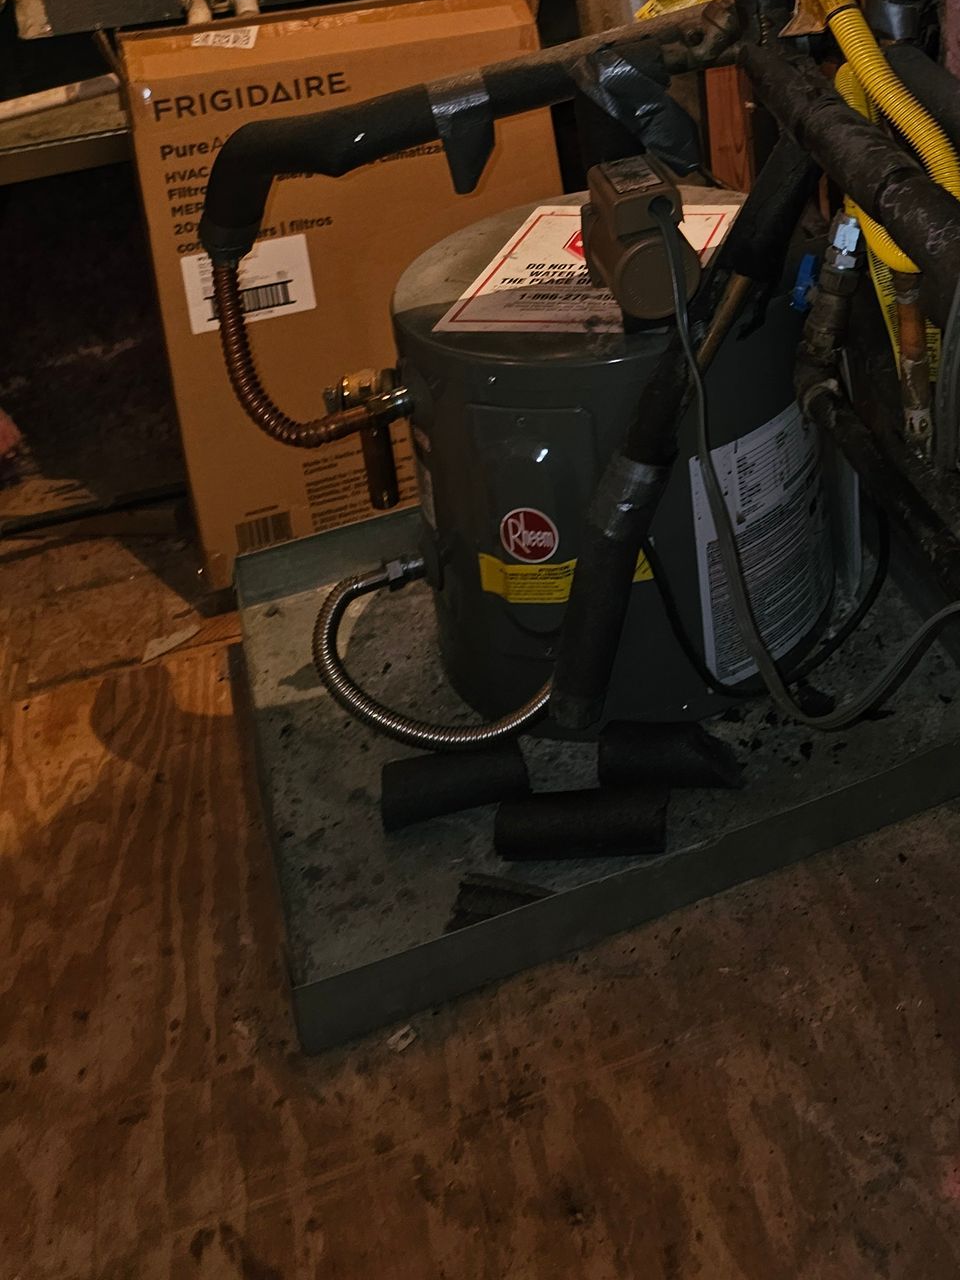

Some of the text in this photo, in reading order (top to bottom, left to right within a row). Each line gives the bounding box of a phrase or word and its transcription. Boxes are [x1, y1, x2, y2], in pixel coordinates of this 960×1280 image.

[153, 72, 347, 122] FRIGIDAIRE
[165, 166, 209, 185] HVAC
[288, 215, 334, 233] filtros
[507, 512, 554, 553] Rheem
